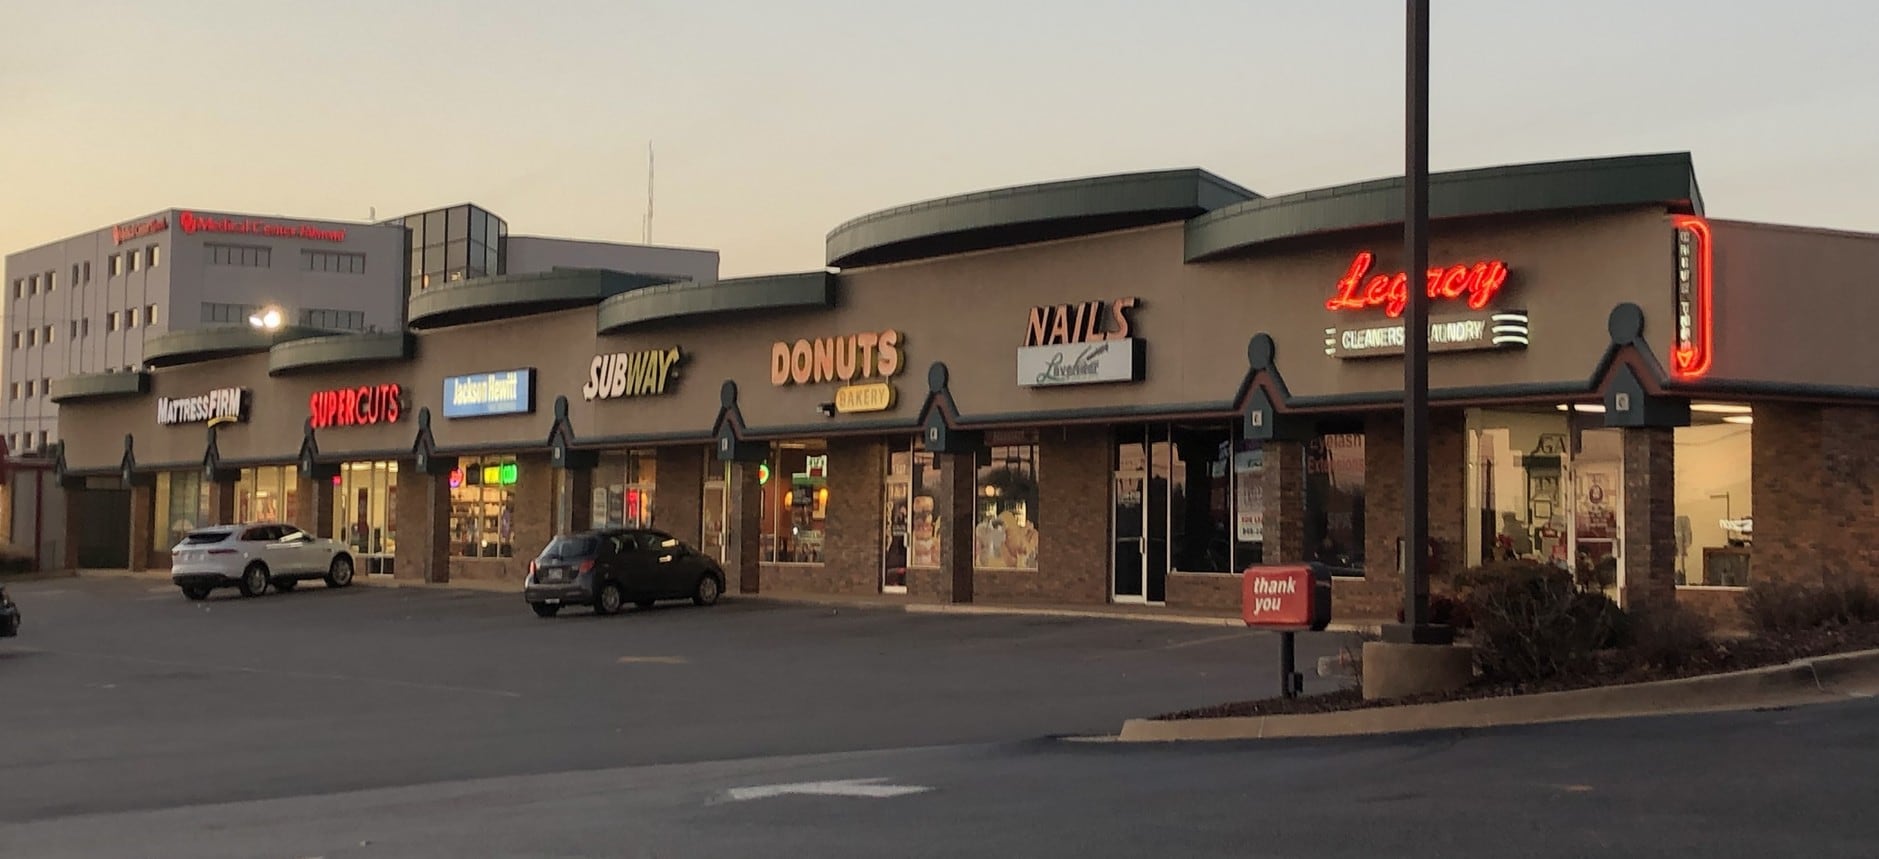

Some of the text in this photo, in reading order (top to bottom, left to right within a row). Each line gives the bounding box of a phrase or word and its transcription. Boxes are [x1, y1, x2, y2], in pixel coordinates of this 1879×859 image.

[1024, 296, 1135, 347] NAILS
[1341, 319, 1486, 349] CLEANERS AUNDRY
[582, 345, 680, 401] SUBWAY
[771, 328, 899, 386] DONUTS
[453, 371, 517, 405] Jackson Hewitt
[839, 388, 887, 408] BAKERY
[309, 383, 399, 428] SUPERCUTS
[1253, 575, 1297, 595] thank
[1253, 597, 1282, 617] you
